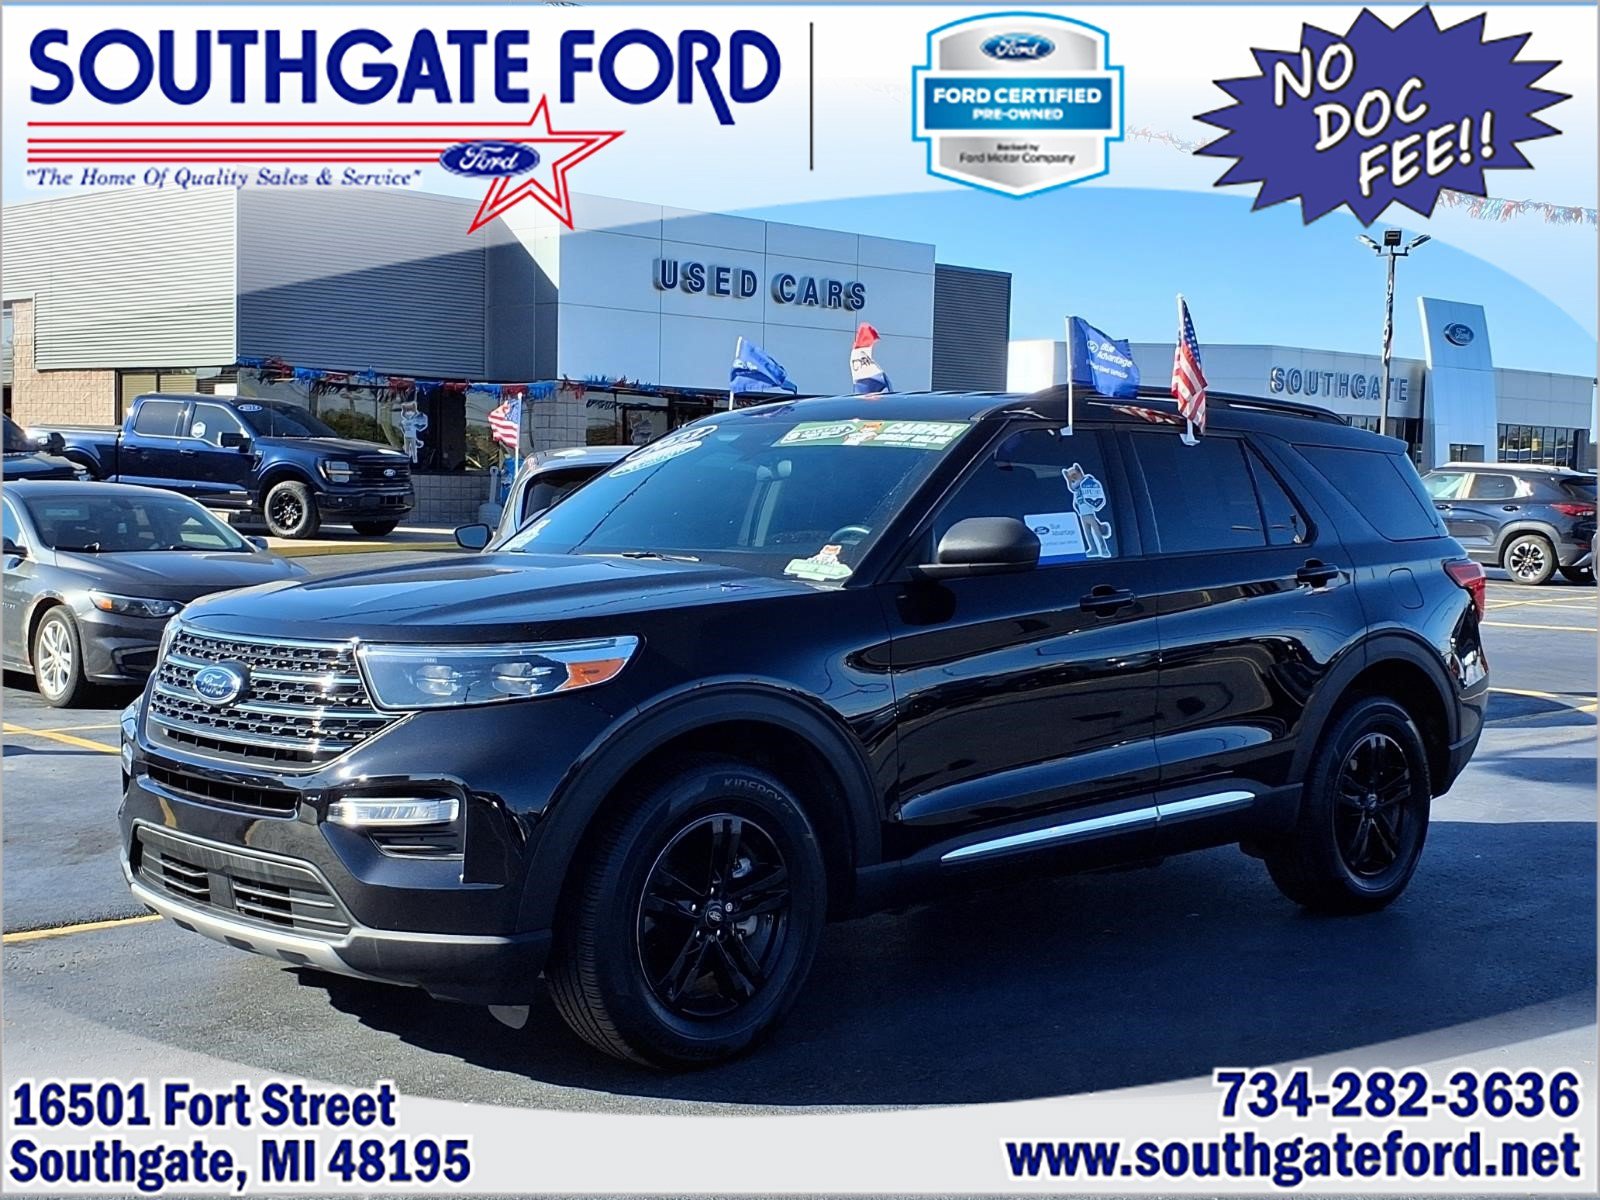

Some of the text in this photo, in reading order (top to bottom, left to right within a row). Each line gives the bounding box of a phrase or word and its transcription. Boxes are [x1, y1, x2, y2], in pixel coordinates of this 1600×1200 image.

[653, 258, 866, 311] USED CARS
[1101, 342, 1115, 353] Blue
[1270, 366, 1408, 402] SOUTHGATE
[883, 422, 965, 437] CARFAX
